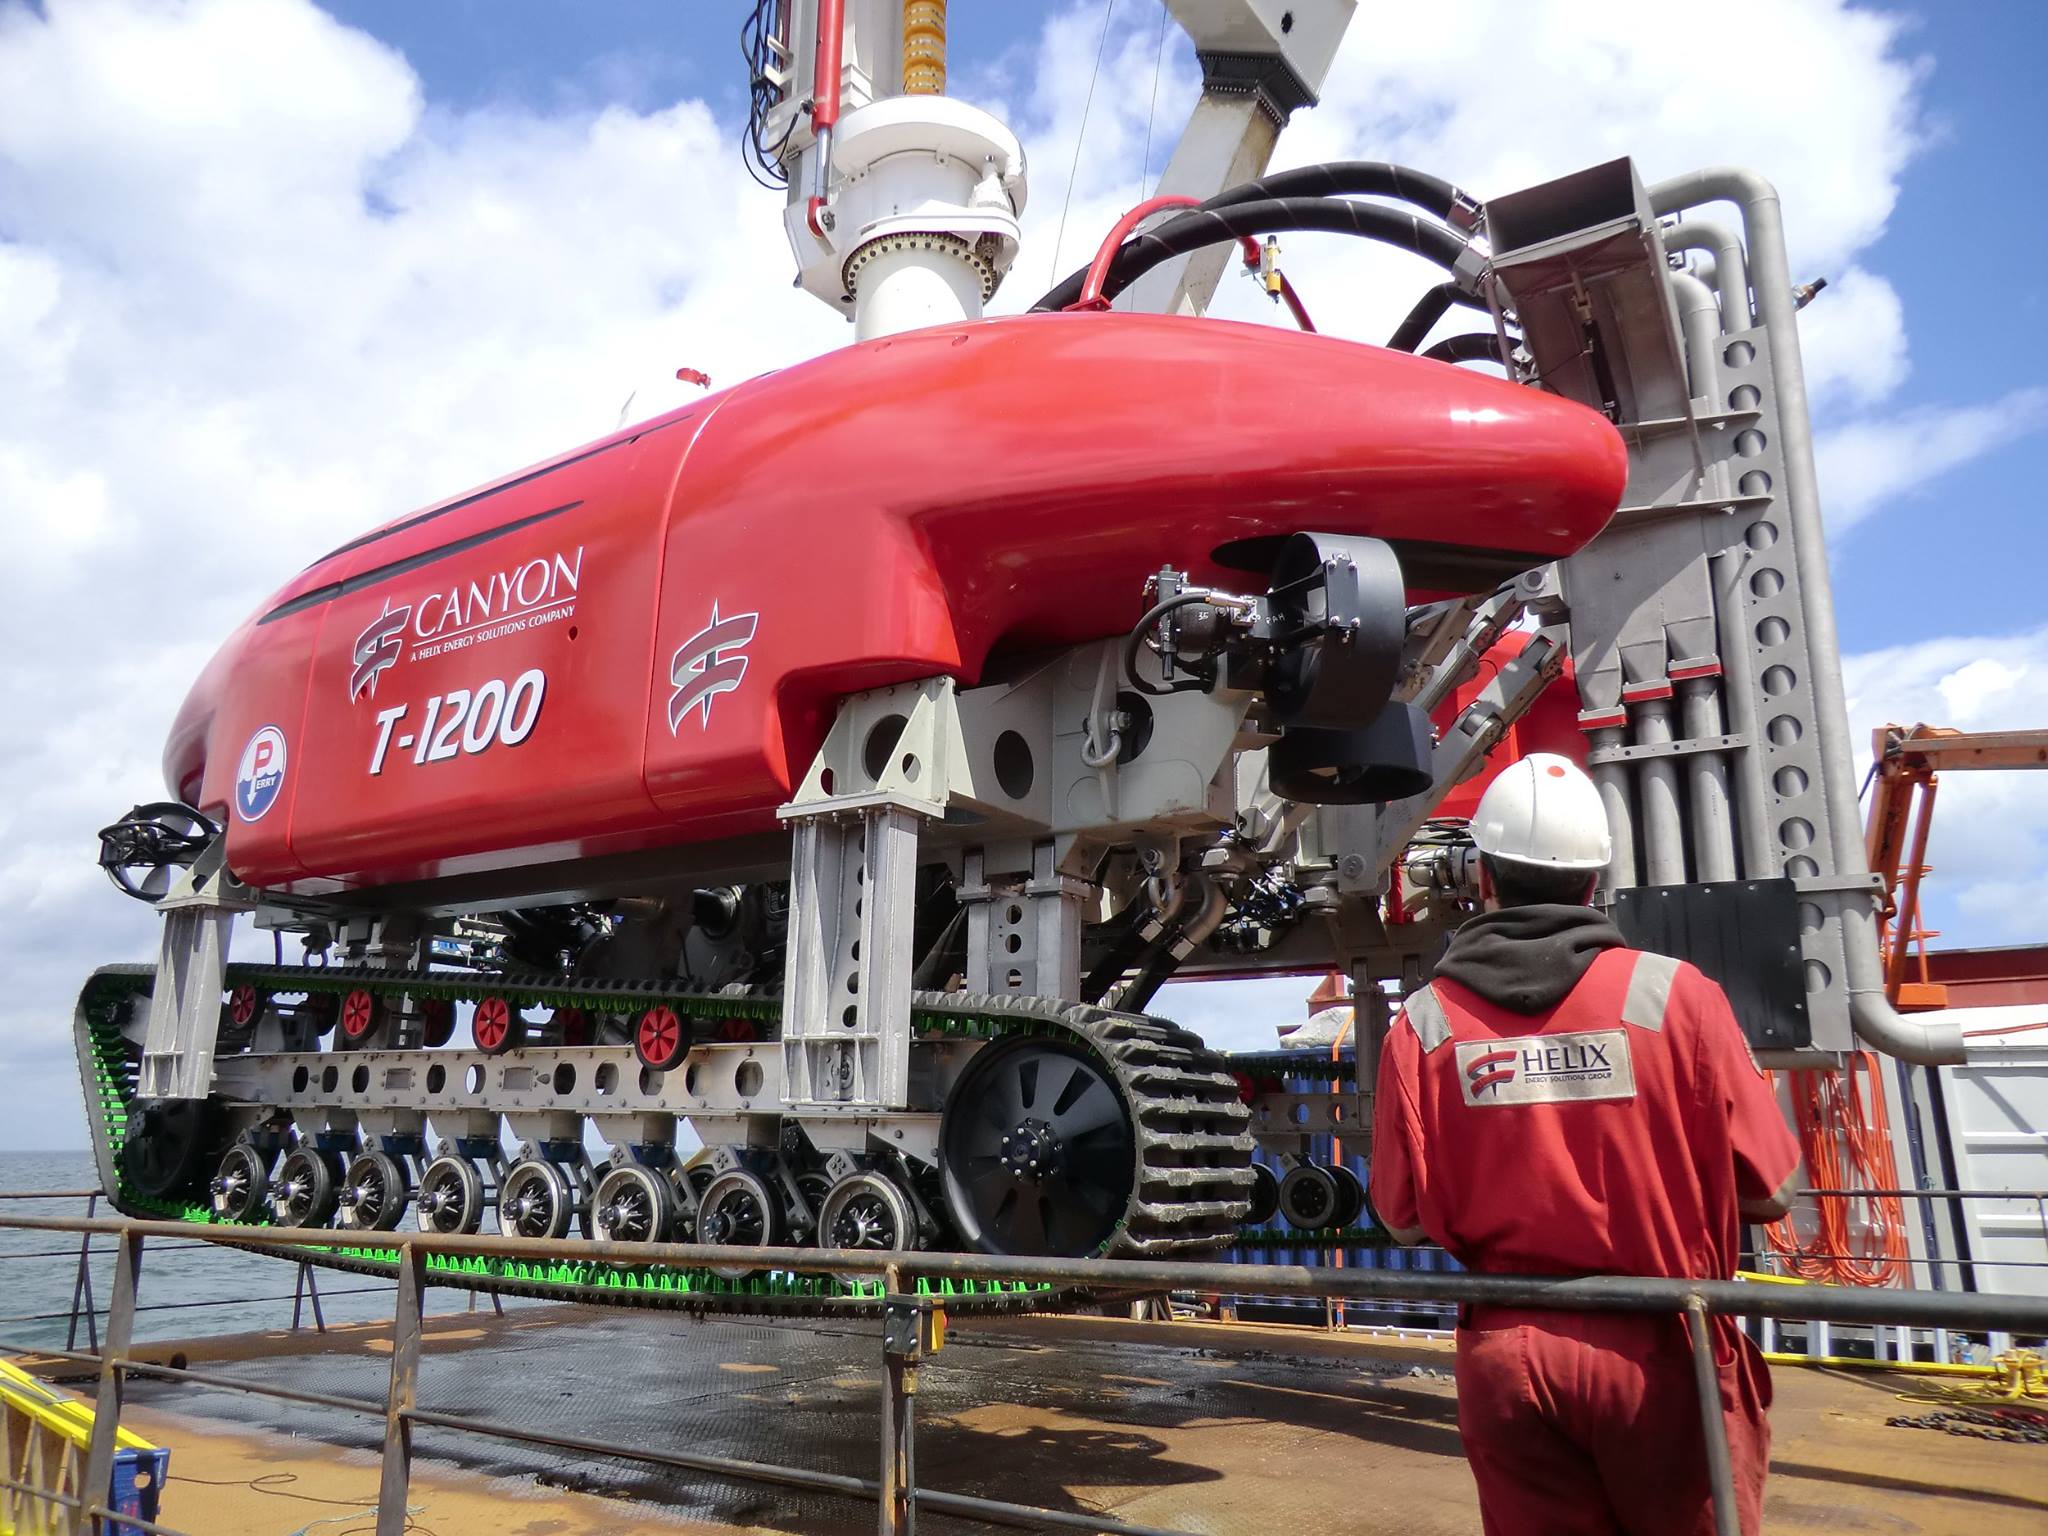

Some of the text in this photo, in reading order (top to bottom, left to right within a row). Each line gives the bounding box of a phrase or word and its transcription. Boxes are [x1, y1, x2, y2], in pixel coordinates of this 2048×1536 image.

[415, 546, 584, 637] CANYON
[410, 605, 575, 662] A HELIX ENERGY SOLUTIONS COMPANY
[369, 669, 547, 775] T-1200
[1522, 1043, 1611, 1072] HELIX
[1525, 1072, 1612, 1084] ENERGY SOLUTIONS GROUP
